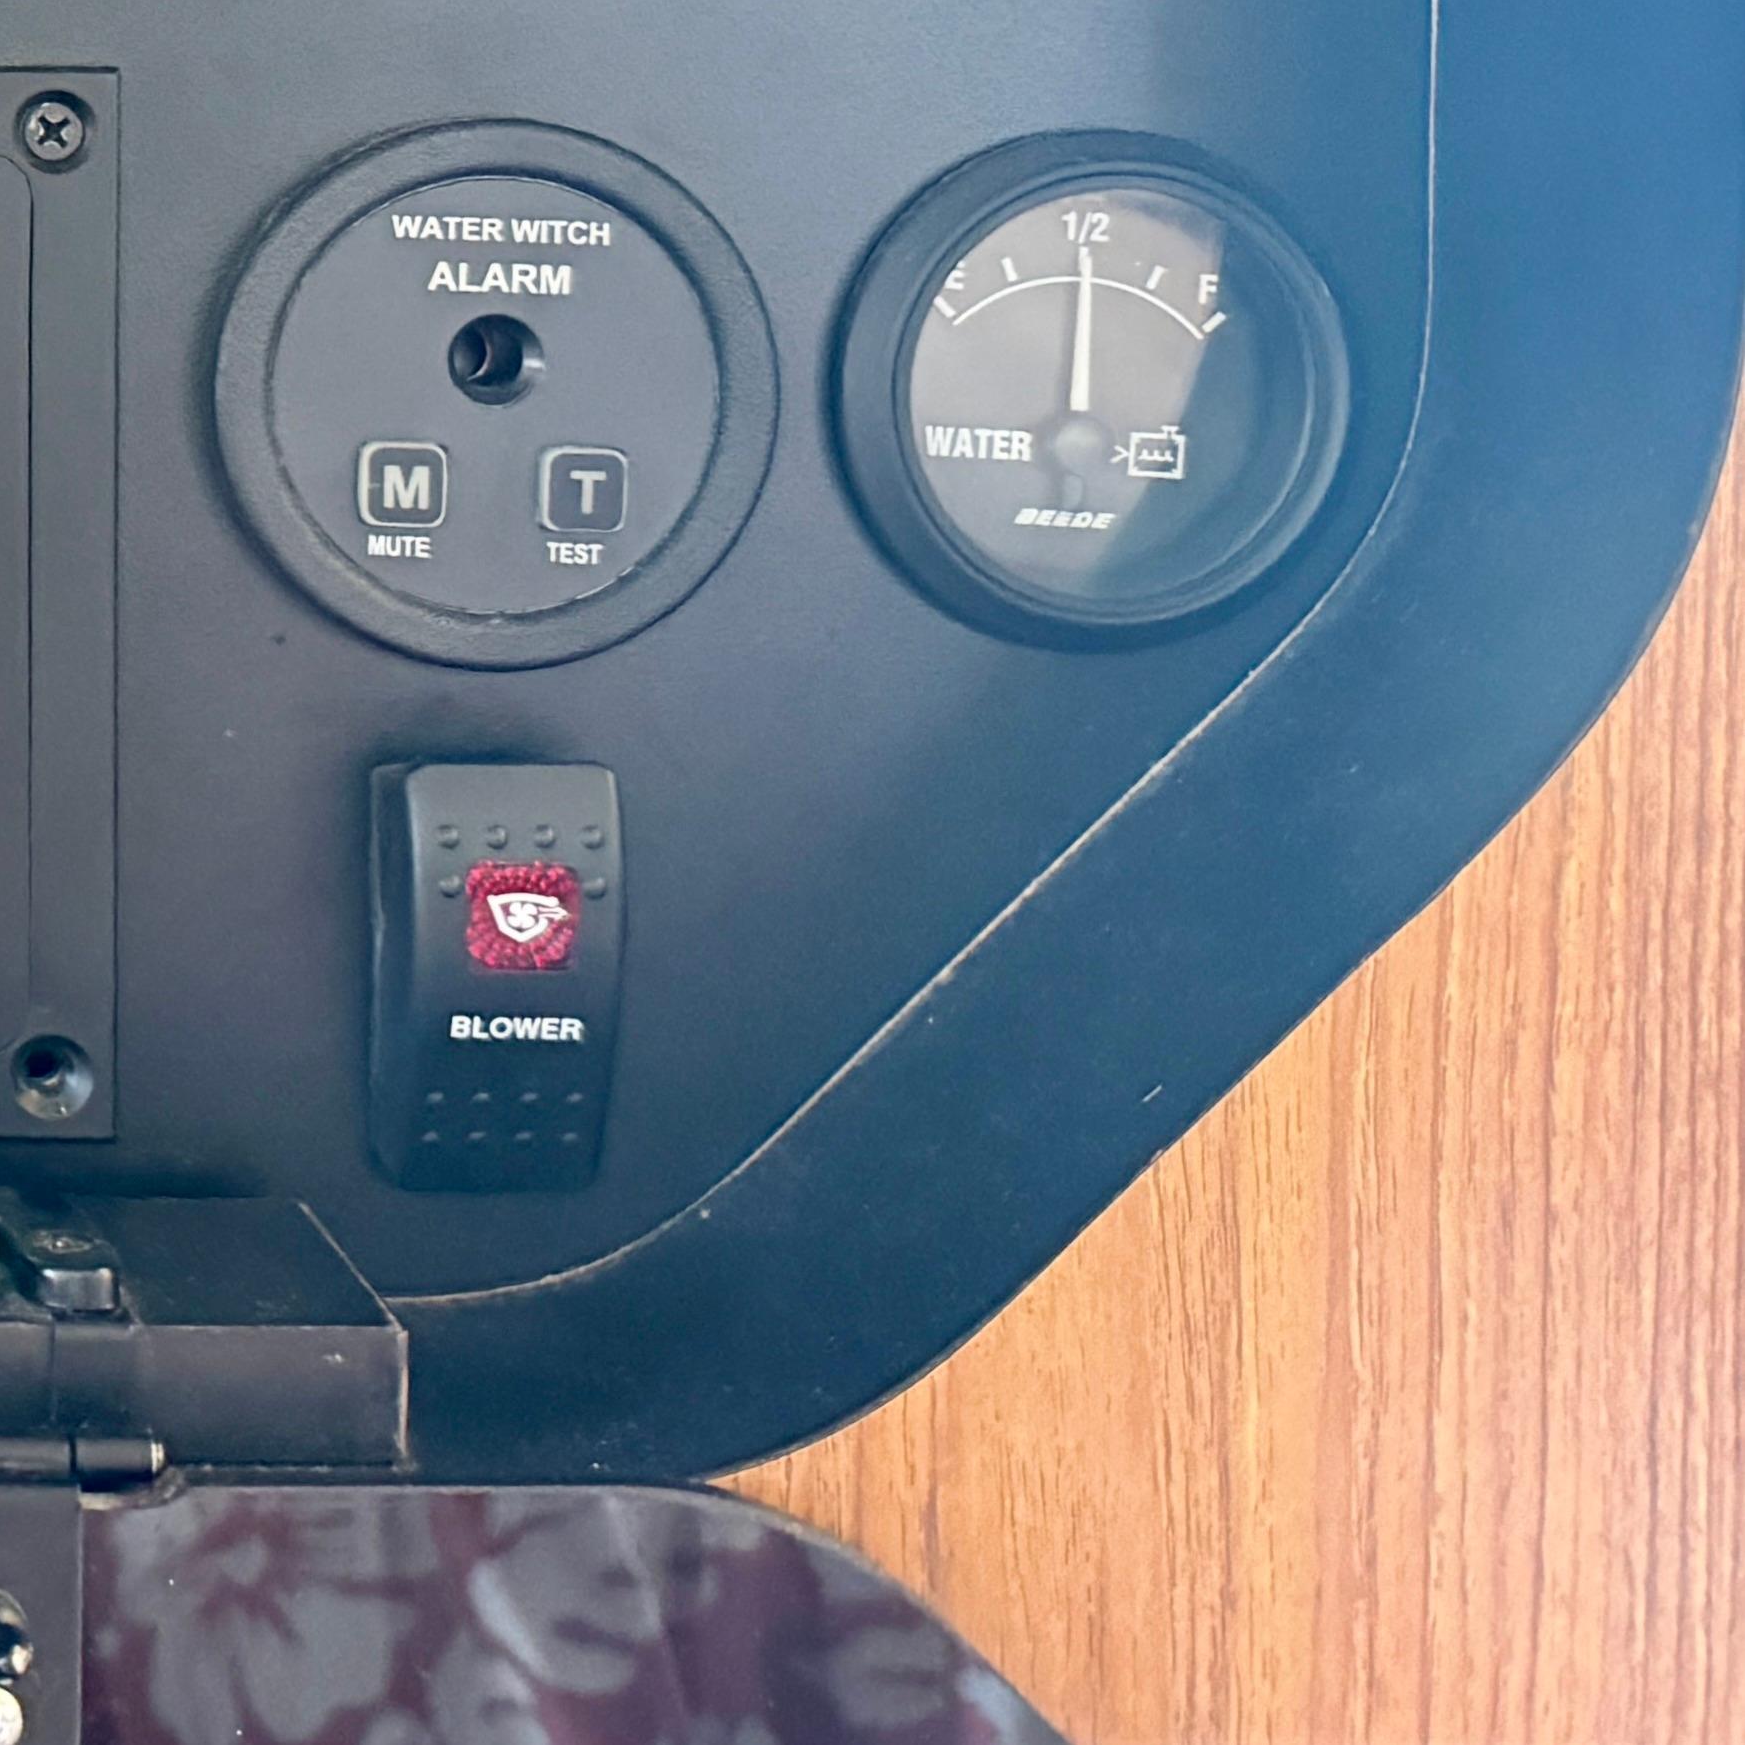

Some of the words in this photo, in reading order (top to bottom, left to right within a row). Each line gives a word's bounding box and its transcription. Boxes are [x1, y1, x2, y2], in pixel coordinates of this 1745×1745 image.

[391, 214, 504, 242] WATER
[510, 218, 611, 246] WITCH
[1061, 211, 1111, 244] 1/2
[427, 261, 572, 295] ALARM
[1200, 275, 1218, 304] F
[925, 423, 1032, 461] WATER
[382, 466, 429, 510] M
[570, 471, 606, 514] T
[367, 534, 432, 559] MUTE
[546, 541, 604, 565] TEST
[450, 1015, 584, 1041] BLOWER
